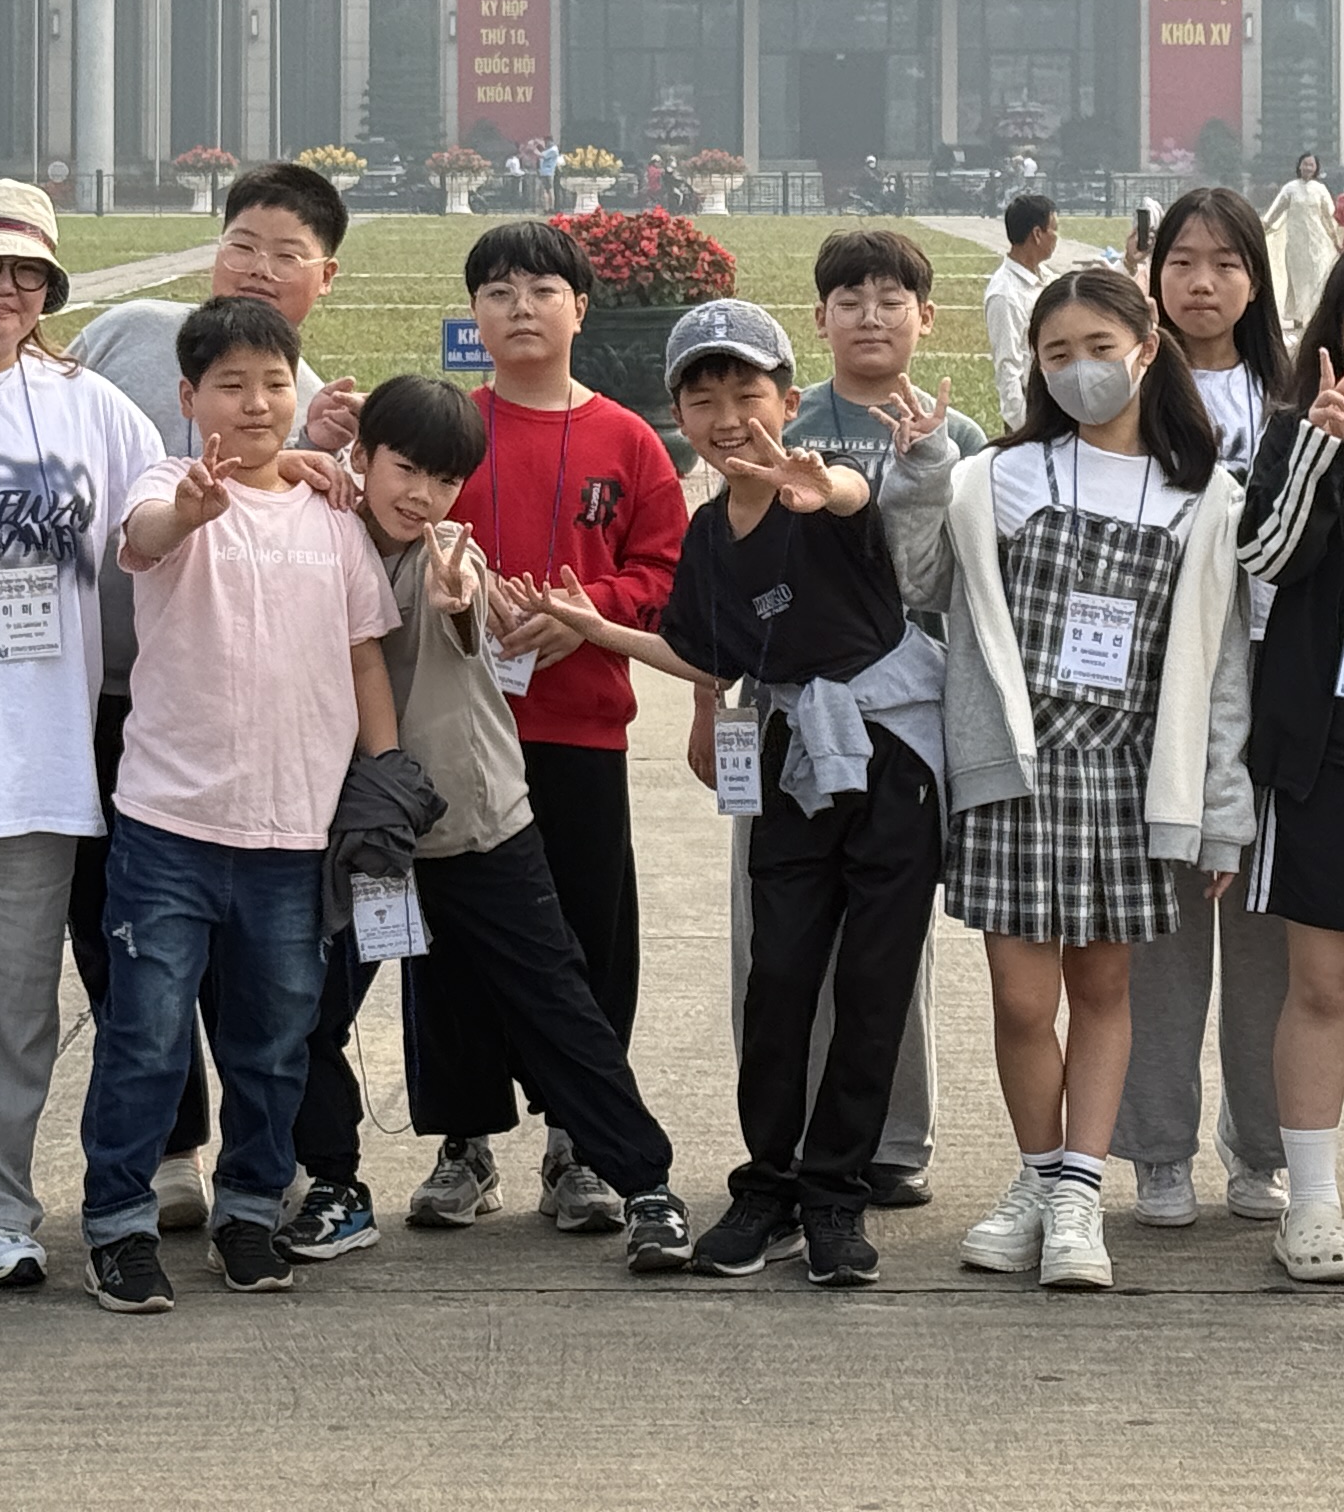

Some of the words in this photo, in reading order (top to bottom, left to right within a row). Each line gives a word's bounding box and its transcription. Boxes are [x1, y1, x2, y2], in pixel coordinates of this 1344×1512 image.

[510, 28, 530, 47] 10,
[1161, 18, 1206, 46] KHÓA
[1210, 22, 1232, 46] XV
[474, 51, 510, 76] QUỐC
[513, 54, 536, 78] HỘI
[477, 82, 513, 104] KHÓA
[516, 85, 534, 104] XV
[458, 328, 481, 345] KH
[214, 544, 284, 564] HEAING
